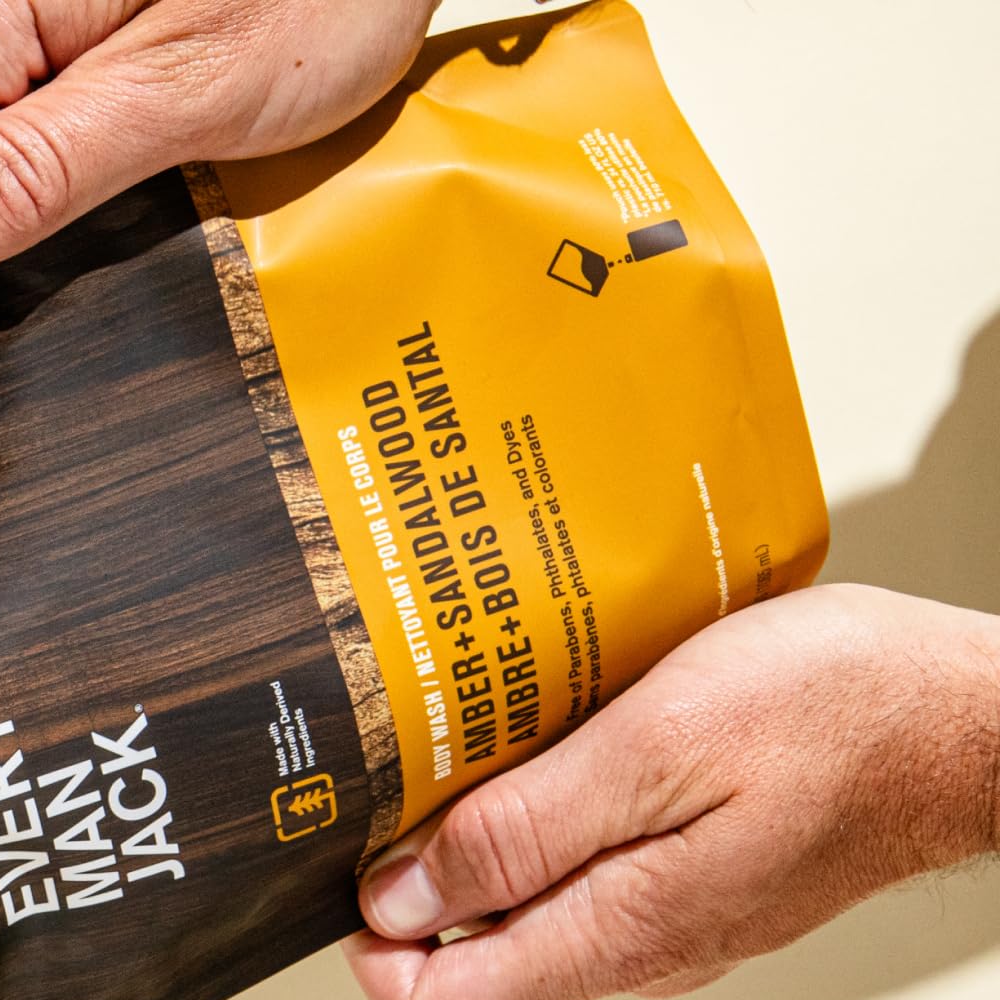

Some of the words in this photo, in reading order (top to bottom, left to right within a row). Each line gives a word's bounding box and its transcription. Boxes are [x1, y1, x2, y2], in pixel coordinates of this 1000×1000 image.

[397, 321, 467, 458] SANTAL
[337, 425, 373, 489] CORPS
[498, 419, 522, 464] Dyes
[518, 413, 554, 494] colorants
[360, 493, 382, 514] LE
[440, 465, 486, 516] DE
[511, 467, 534, 500] and
[545, 497, 561, 515] et
[693, 463, 710, 509] naturelle
[368, 518, 401, 570] POUR
[526, 504, 567, 599] Phthalates,
[553, 519, 591, 598] phtalates
[387, 575, 435, 675] NETTOYANT
[559, 601, 581, 679] Parabens,
[580, 601, 603, 682] parabènes,
[269, 680, 291, 724] Derived
[568, 681, 582, 693] of
[268, 721, 282, 745] with
[294, 707, 316, 767] Ingredients
[425, 691, 449, 740] WASH
[275, 746, 289, 776] Made
[284, 725, 302, 772] Naturally
[433, 747, 452, 779] BODY
[36, 759, 124, 910] MAN
